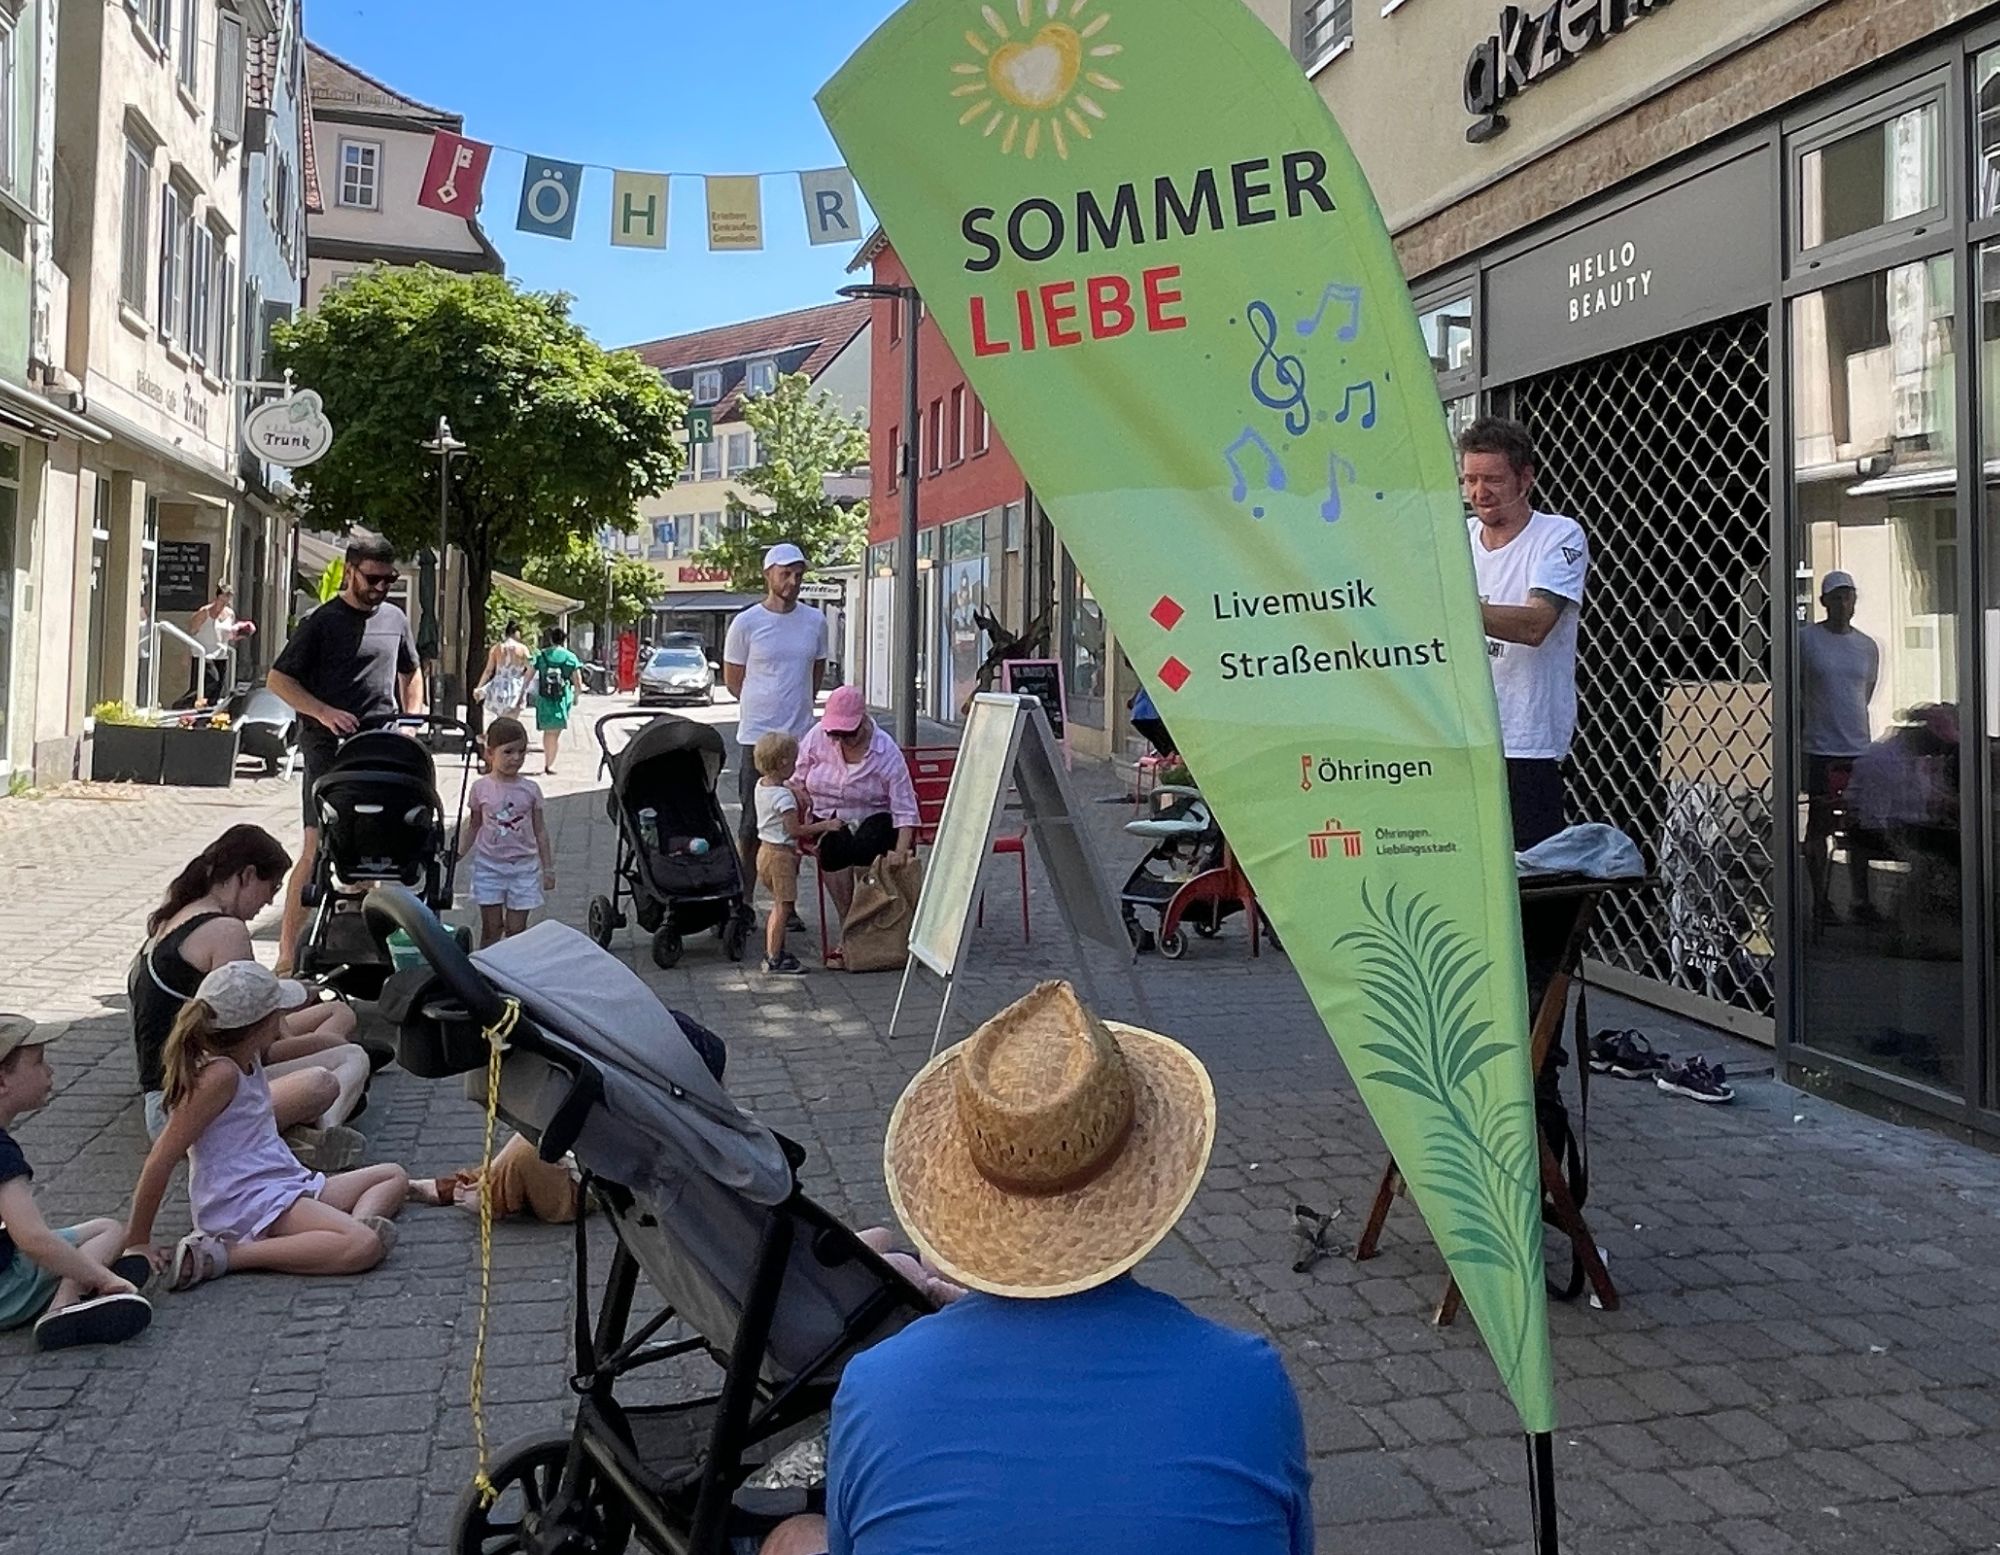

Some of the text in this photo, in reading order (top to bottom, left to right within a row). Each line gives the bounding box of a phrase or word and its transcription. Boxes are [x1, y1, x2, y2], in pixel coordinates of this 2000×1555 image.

[526, 167, 570, 225] Ö
[622, 192, 656, 237] H
[815, 190, 849, 232] R
[962, 149, 1337, 272] SOMMER
[1568, 241, 1636, 289] HELLO
[969, 264, 1188, 358] LIEBE
[1568, 269, 1653, 322] BEAUTY
[263, 432, 311, 450] Trunk
[693, 418, 709, 439] R
[1213, 578, 1377, 620] Livemusik
[1219, 637, 1448, 681] Straßenkunst
[1317, 757, 1433, 785] Öhringen
